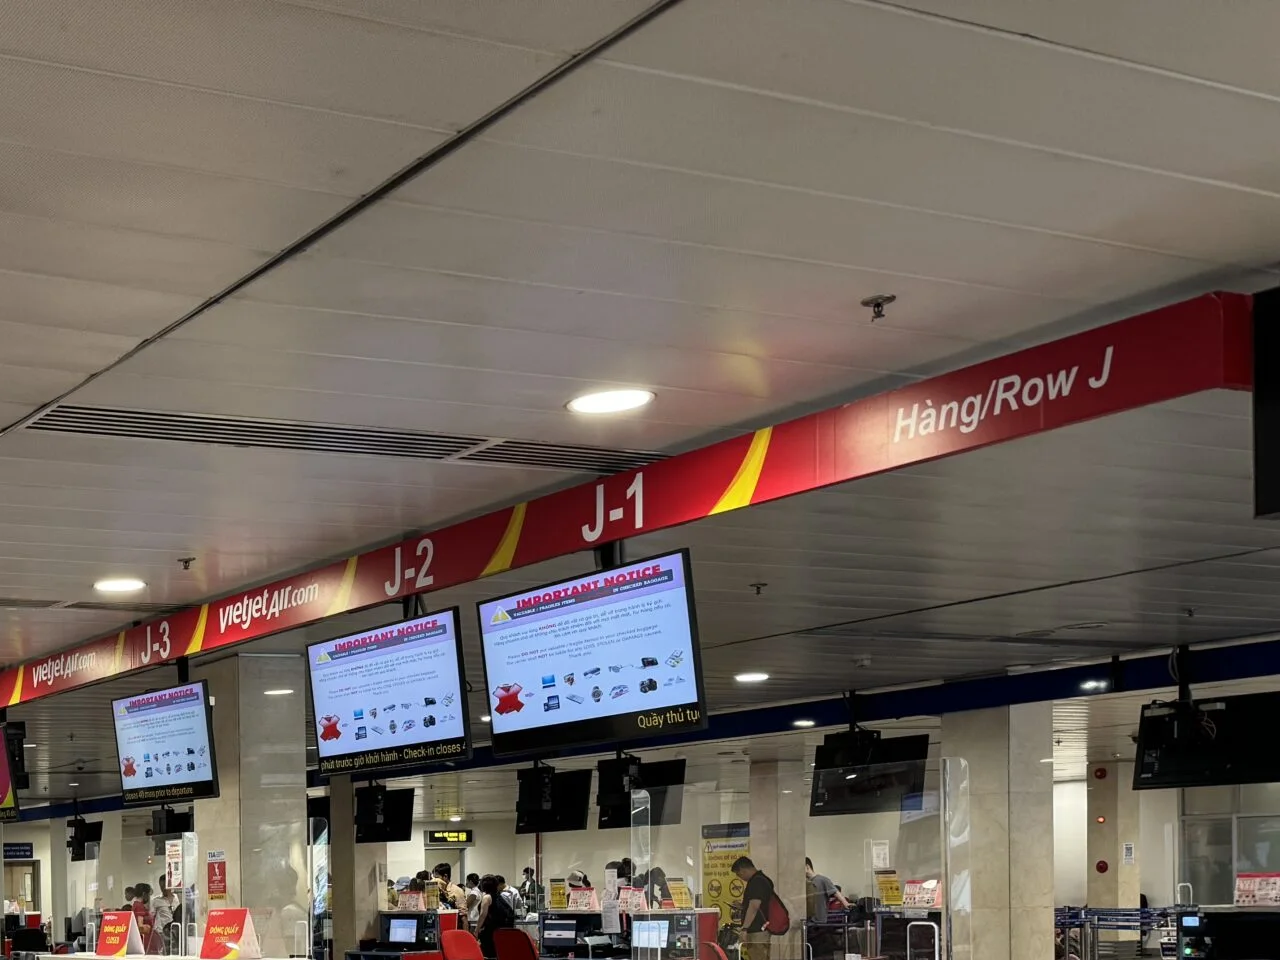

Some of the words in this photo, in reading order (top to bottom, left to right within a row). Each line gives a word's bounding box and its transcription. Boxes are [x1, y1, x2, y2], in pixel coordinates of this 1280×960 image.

[893, 362, 1080, 447] Hàng/Row
[1088, 345, 1114, 391] J
[581, 470, 645, 543] J-1
[384, 538, 434, 597] J-2
[515, 579, 600, 610] IMPORTANT
[603, 564, 662, 588] NOTICE
[140, 621, 172, 664] J-3
[334, 629, 395, 652] IMPORTANT
[397, 619, 438, 637] NOTICE
[637, 712, 664, 728] Quầy
[666, 707, 684, 724] thủ
[403, 746, 435, 760] Check-in
[436, 742, 461, 755] closes
